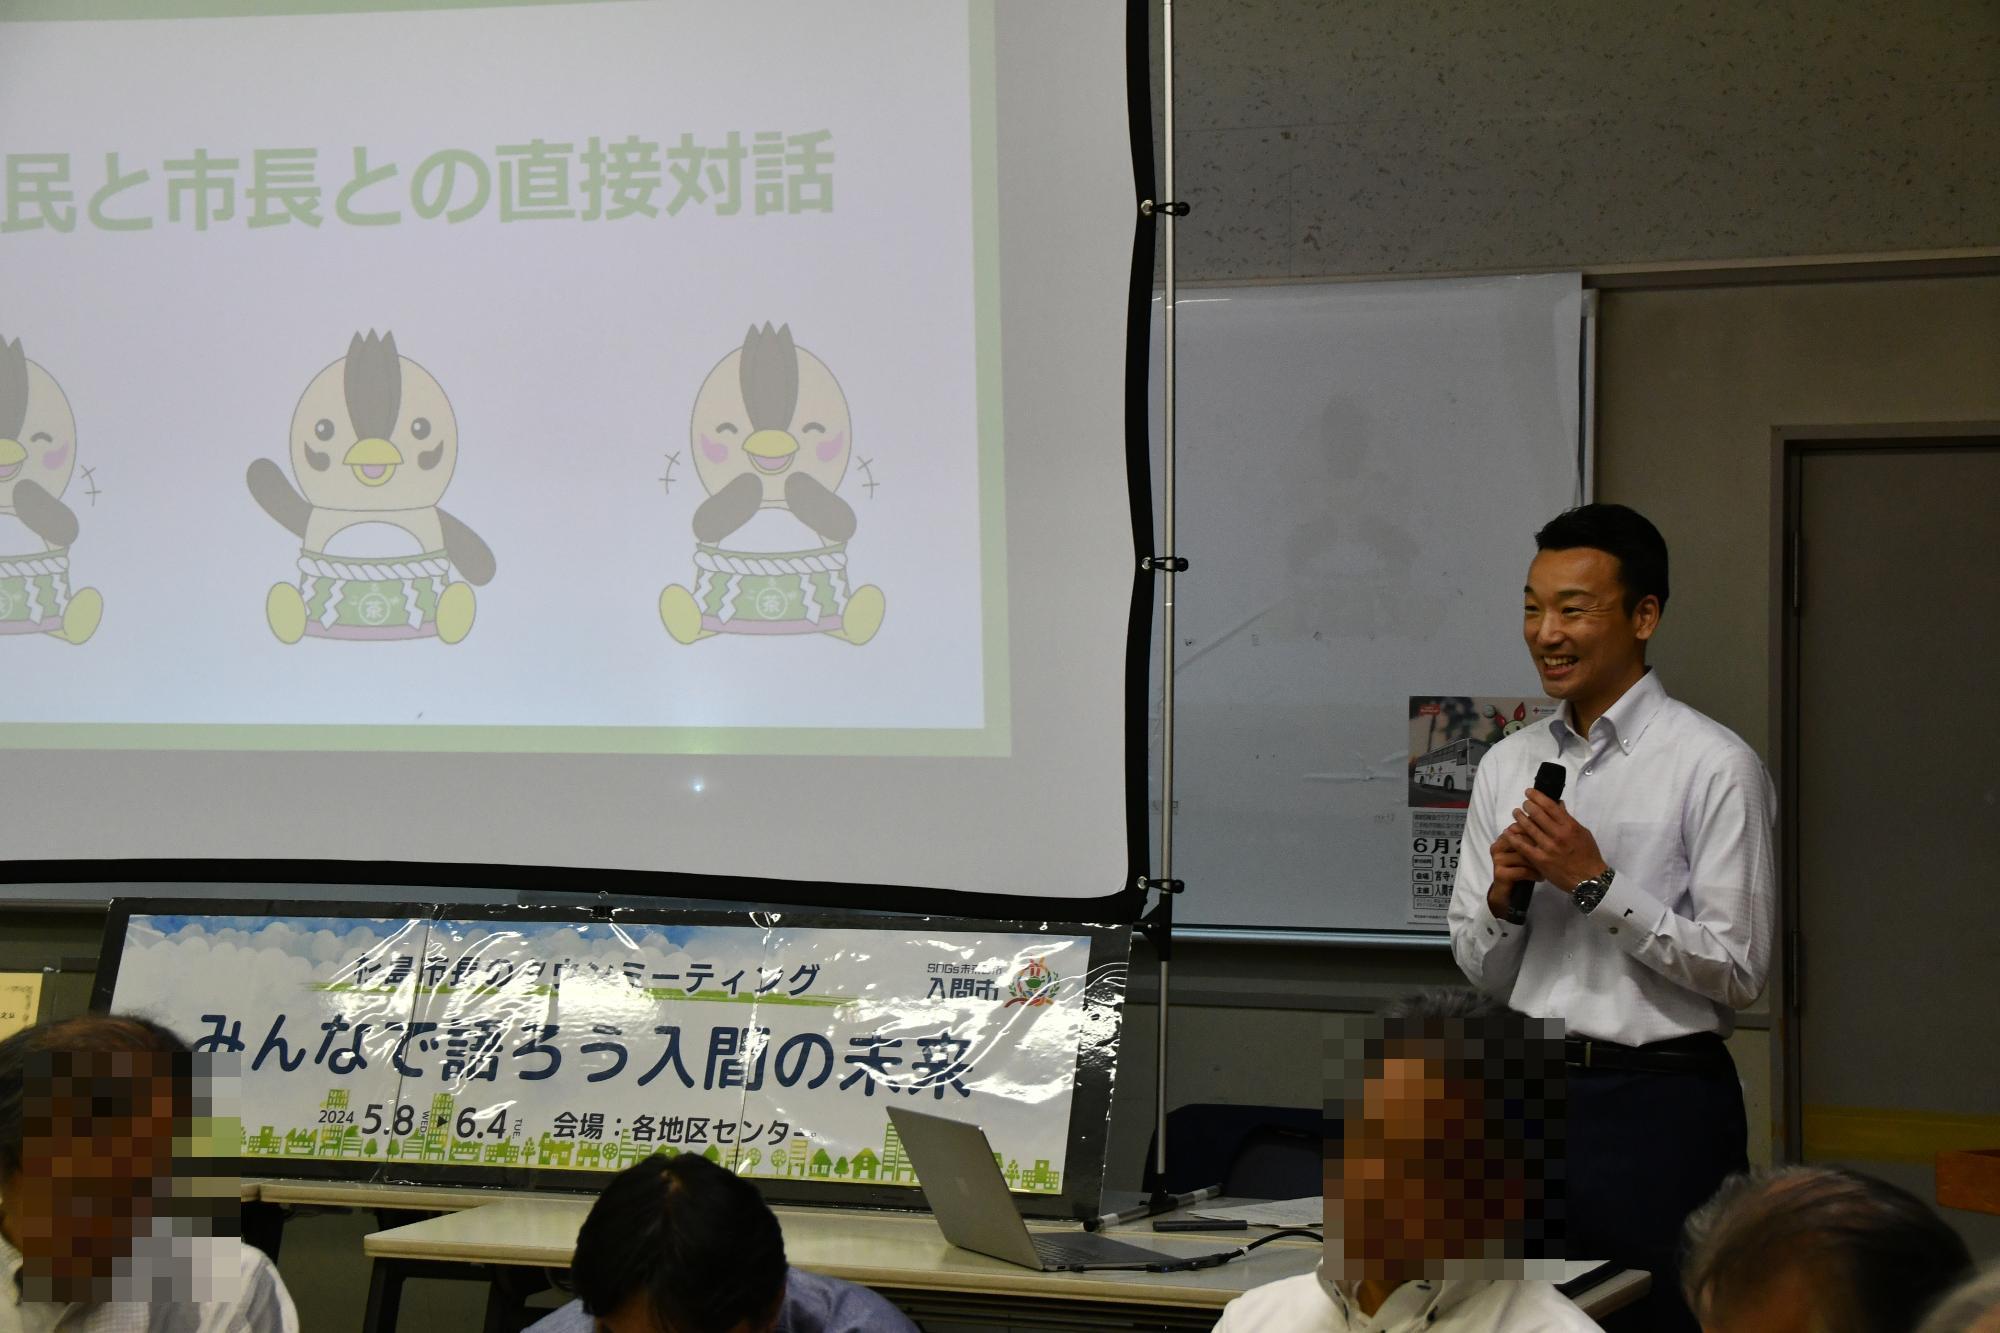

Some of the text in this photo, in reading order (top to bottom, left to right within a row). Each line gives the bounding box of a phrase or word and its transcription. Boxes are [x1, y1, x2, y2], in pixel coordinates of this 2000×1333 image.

[0, 129, 836, 234] 民と市長との直接対話
[927, 977, 999, 1001] 入間市
[318, 1110, 354, 1124] 2024
[361, 1103, 415, 1136] 5.8
[456, 1106, 507, 1139] 6.4
